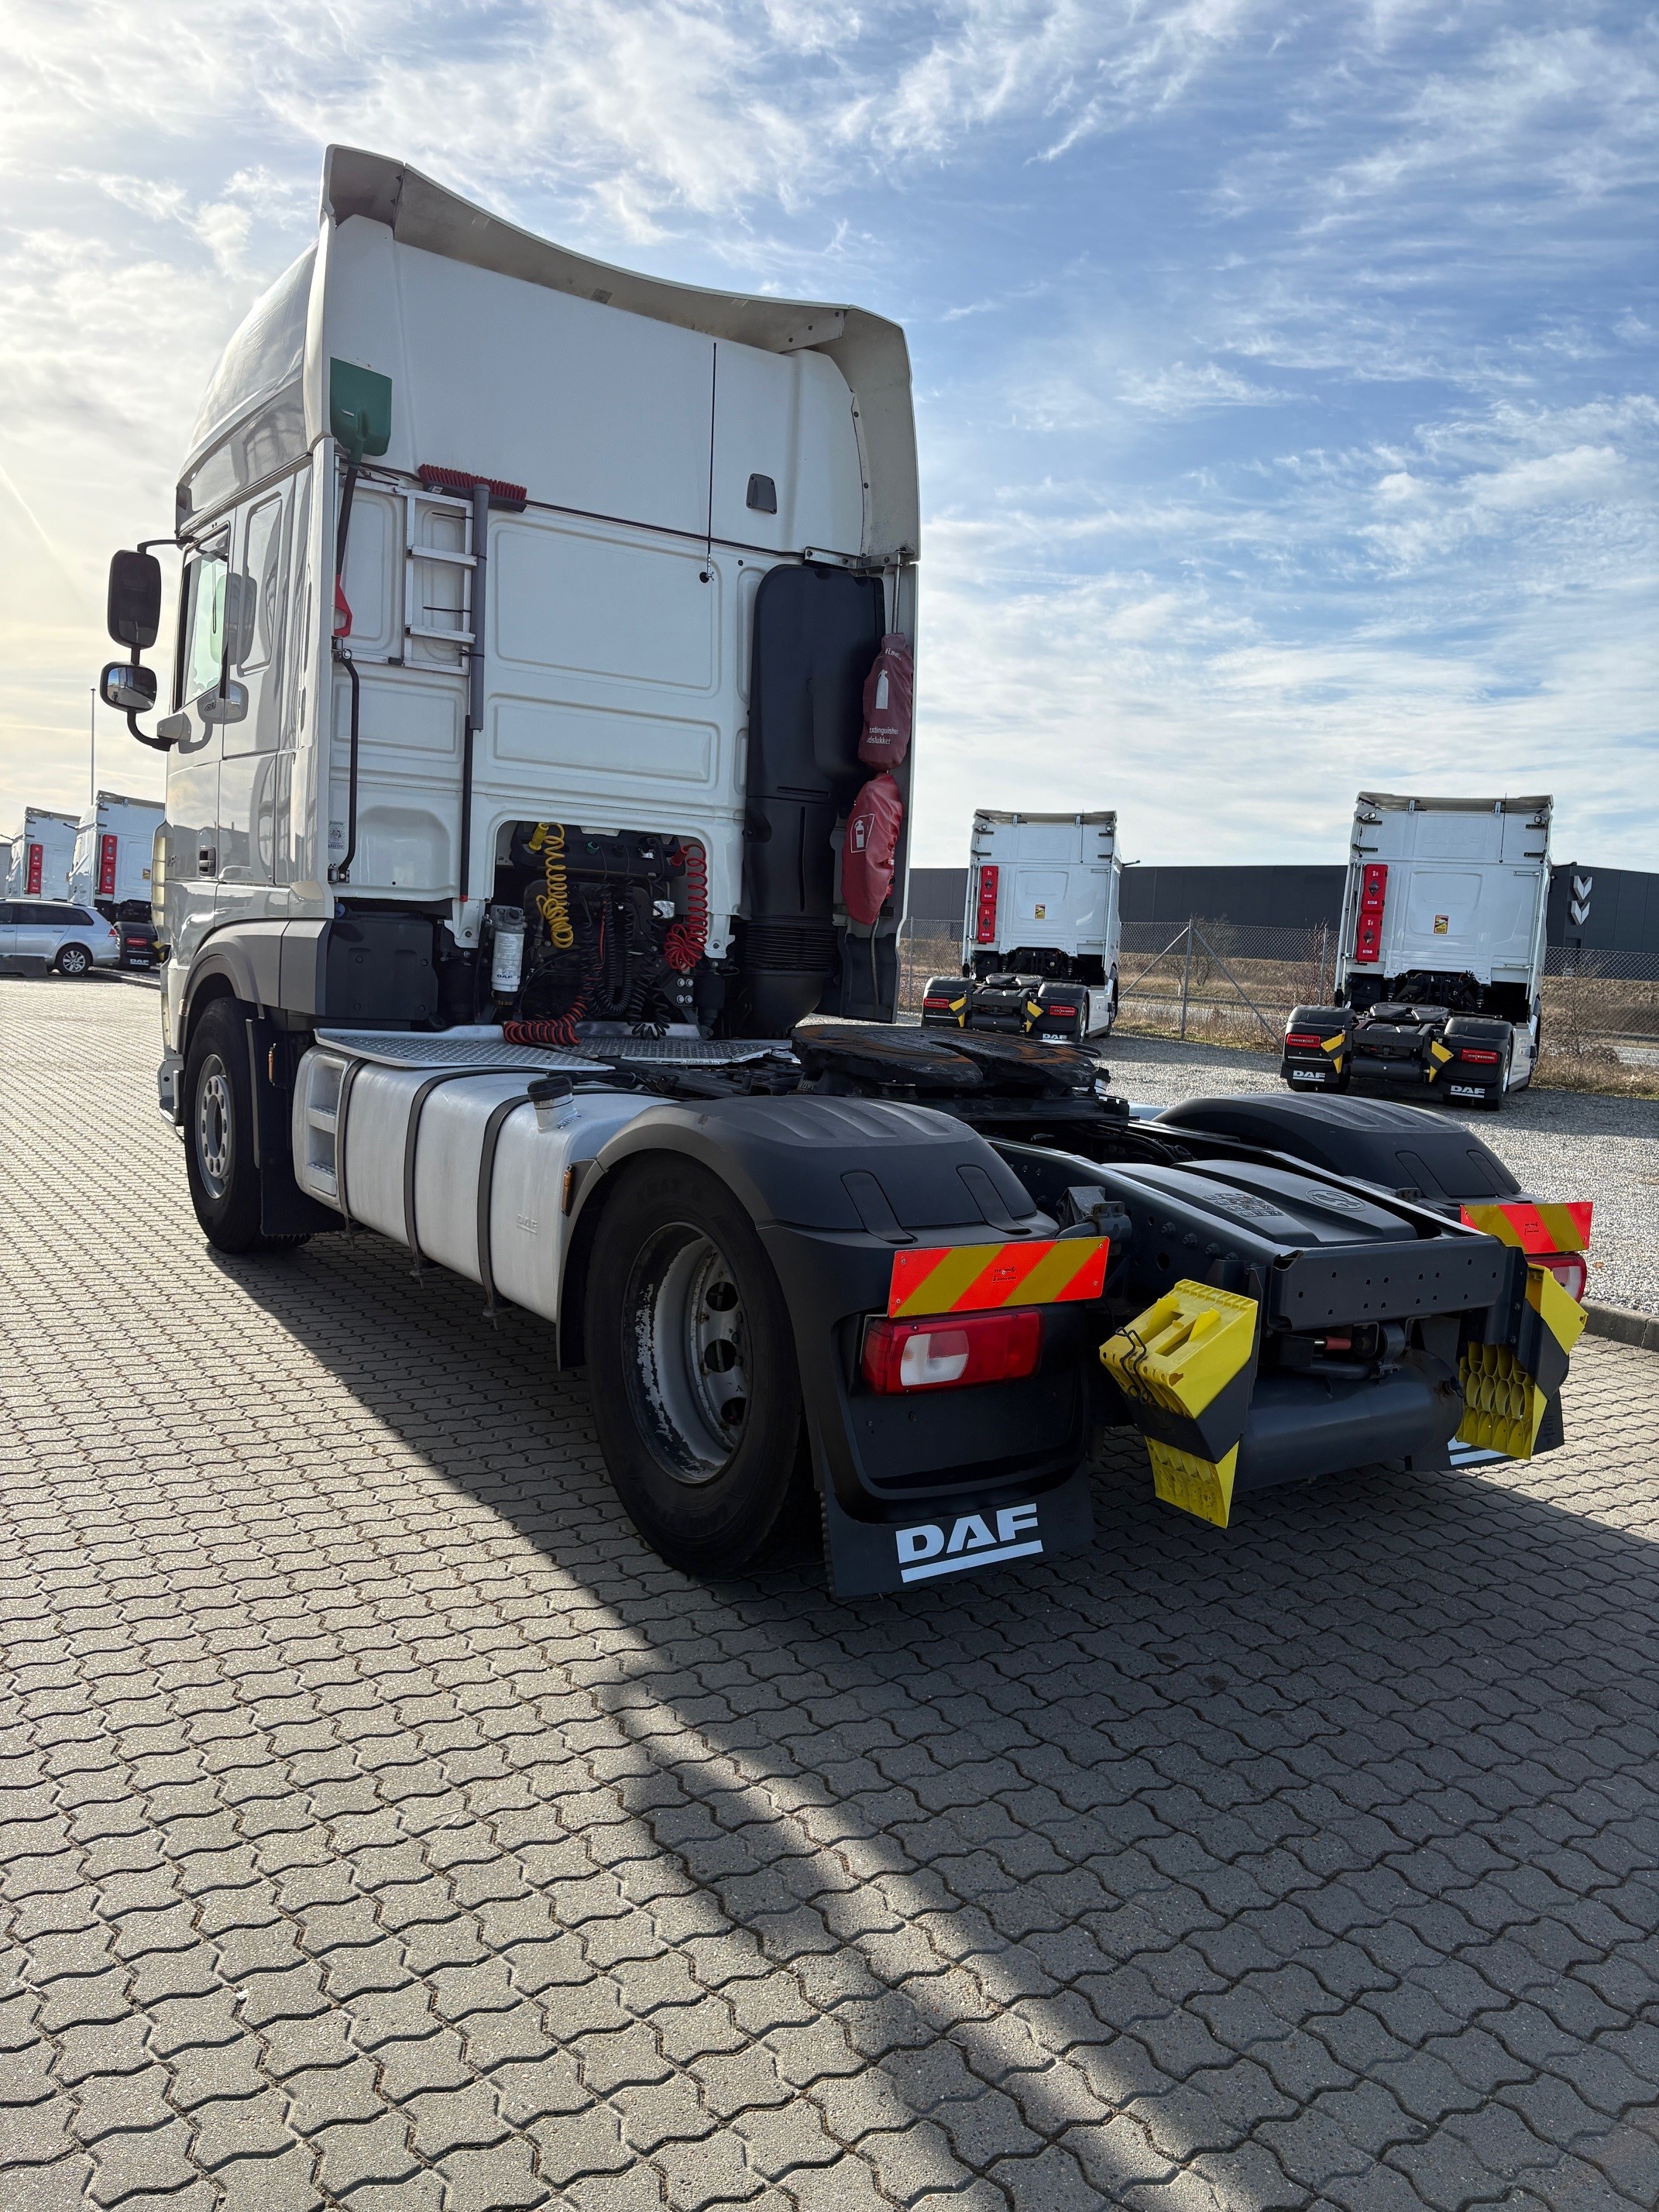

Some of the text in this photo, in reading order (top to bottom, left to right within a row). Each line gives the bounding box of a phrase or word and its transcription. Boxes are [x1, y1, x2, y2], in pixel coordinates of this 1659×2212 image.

[1293, 1070, 1326, 1078] DAF
[1450, 1085, 1486, 1094] DAF
[895, 1503, 1039, 1564] DAF
